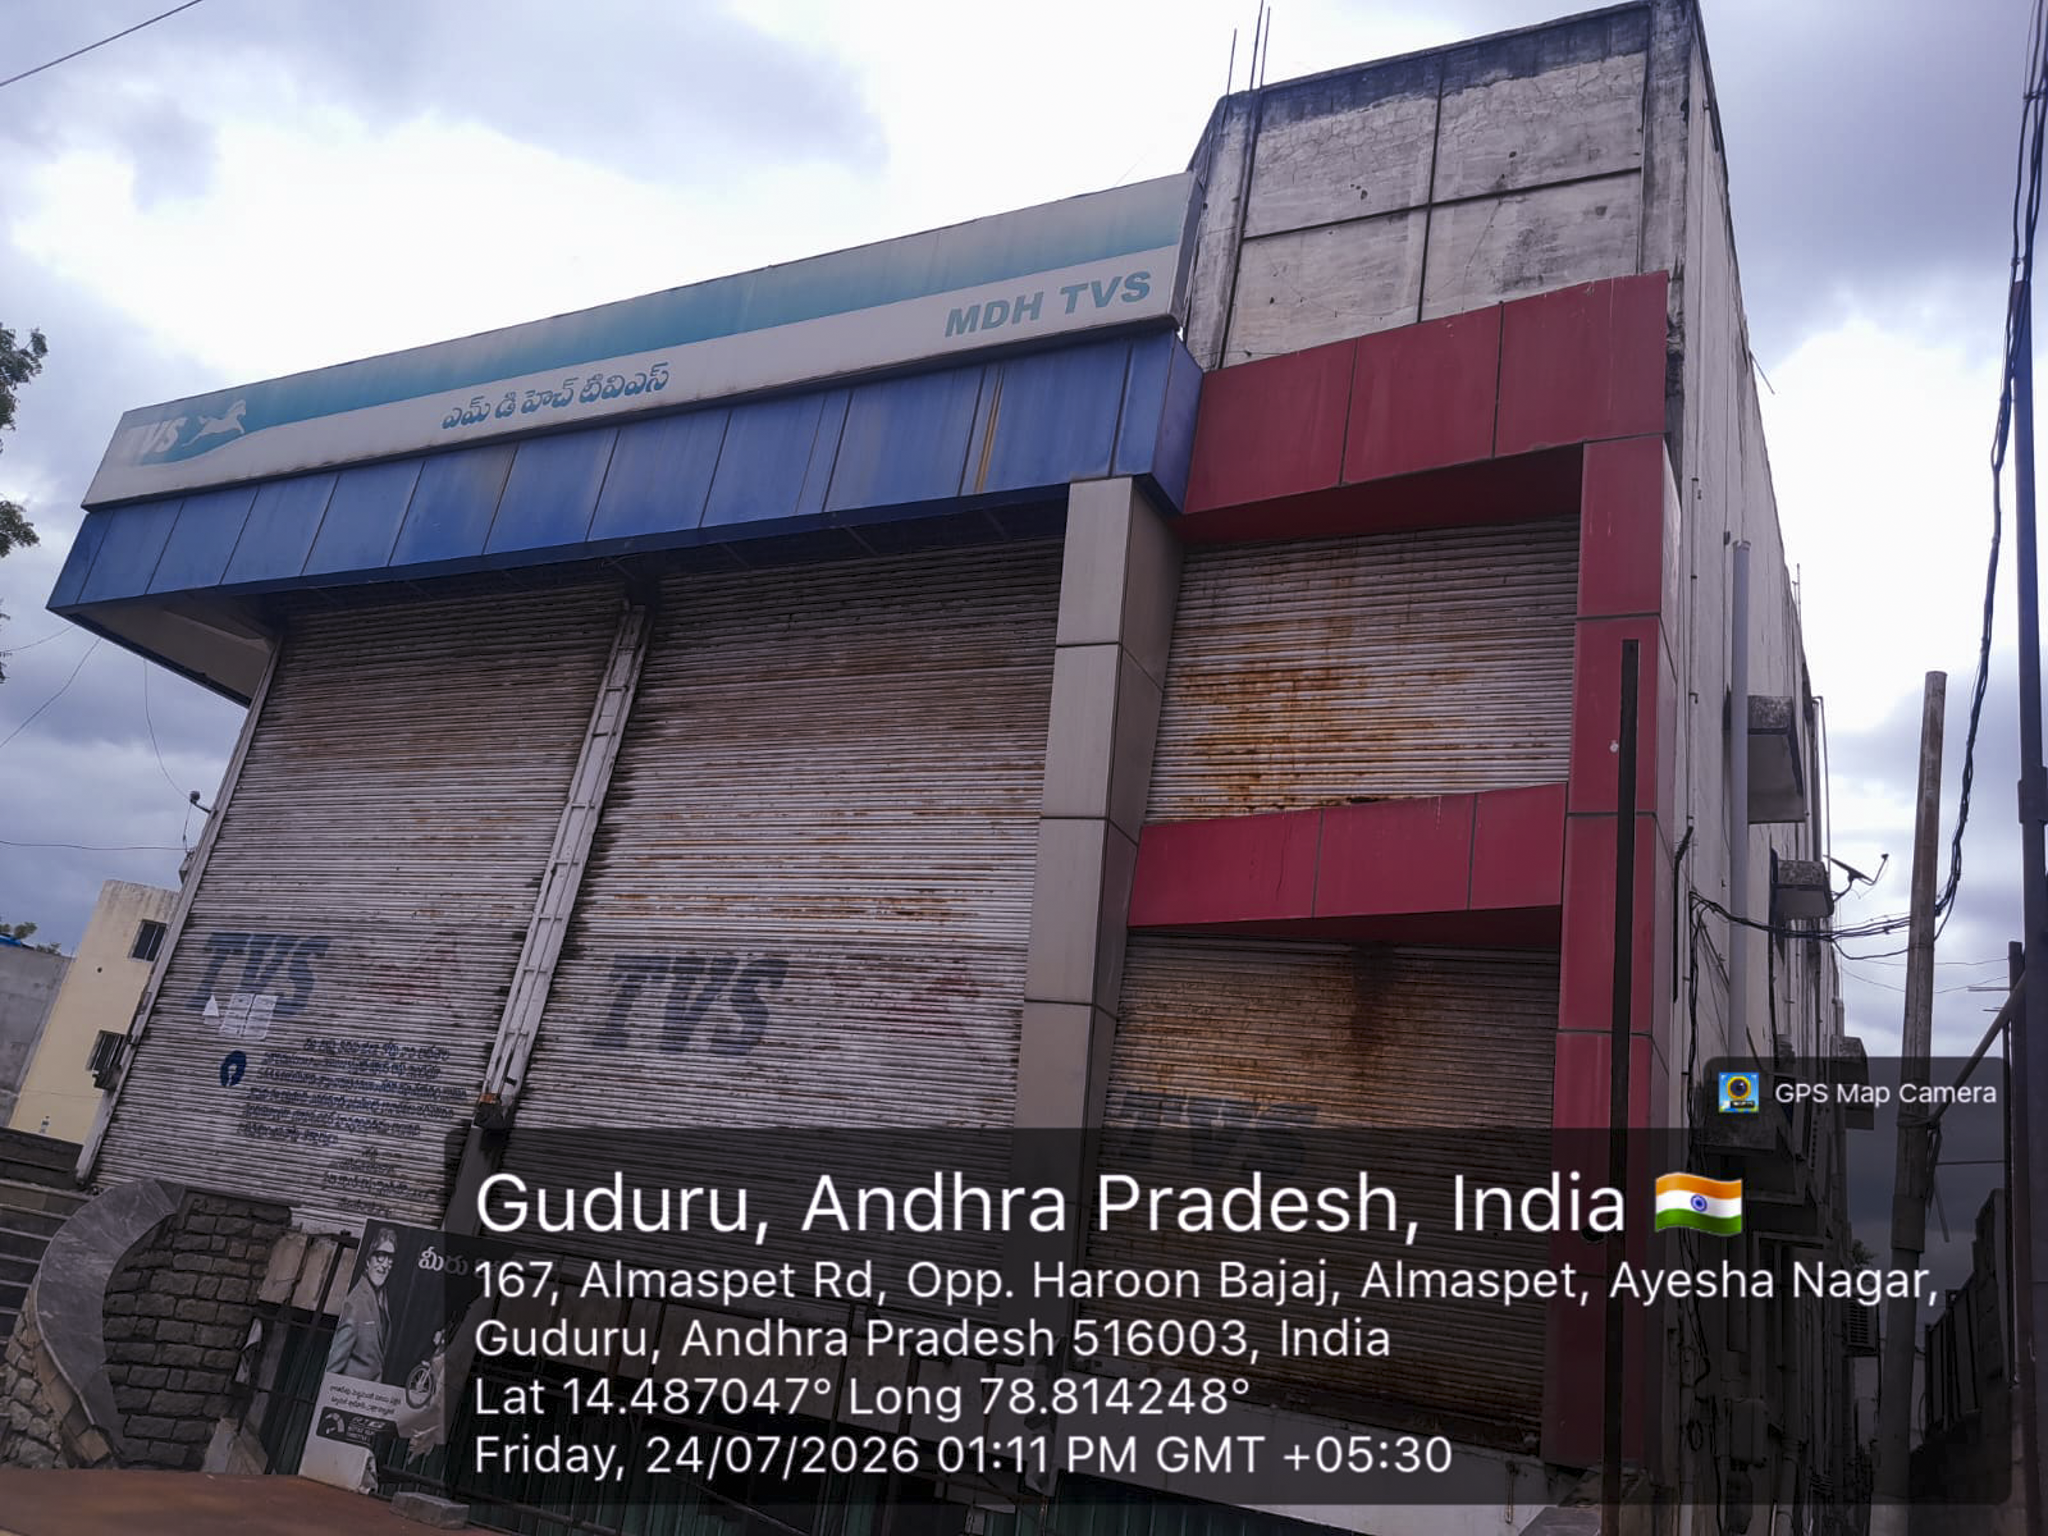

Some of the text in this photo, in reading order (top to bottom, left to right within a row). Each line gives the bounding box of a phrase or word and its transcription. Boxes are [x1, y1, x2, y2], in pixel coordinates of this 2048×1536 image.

[945, 271, 1151, 338] MDH TVS
[185, 932, 329, 1016] TVS
[593, 954, 790, 1056] TVS
